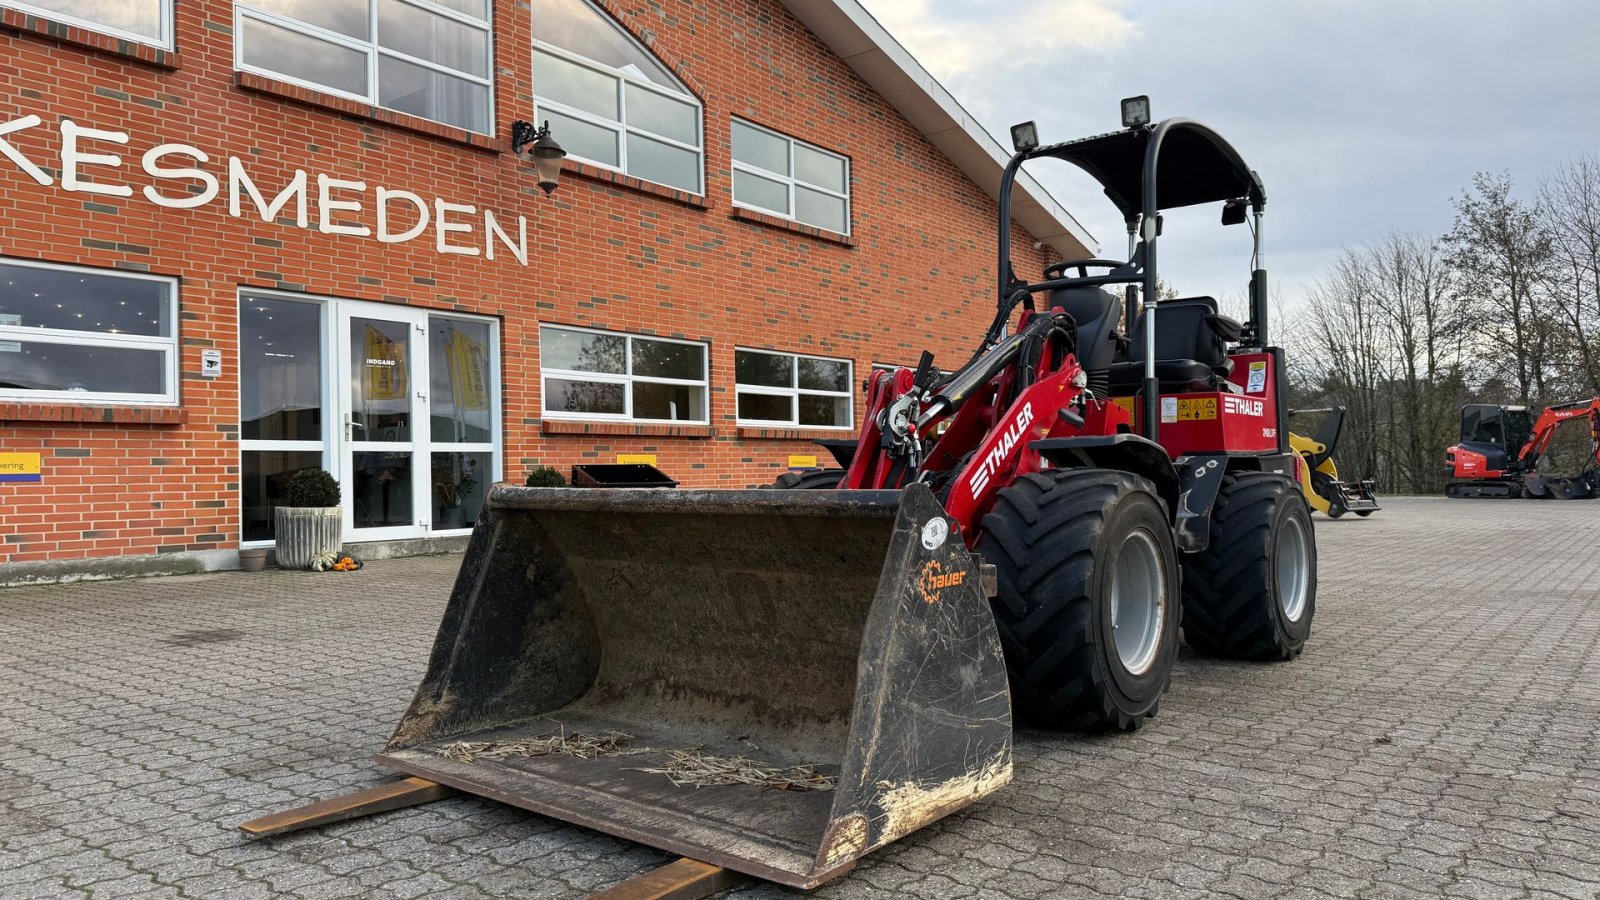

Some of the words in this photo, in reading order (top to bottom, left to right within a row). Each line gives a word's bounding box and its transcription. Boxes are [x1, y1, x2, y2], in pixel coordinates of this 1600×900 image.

[366, 358, 396, 366] INDGANG
[1234, 398, 1264, 417] THALER
[985, 401, 1034, 476] THALER
